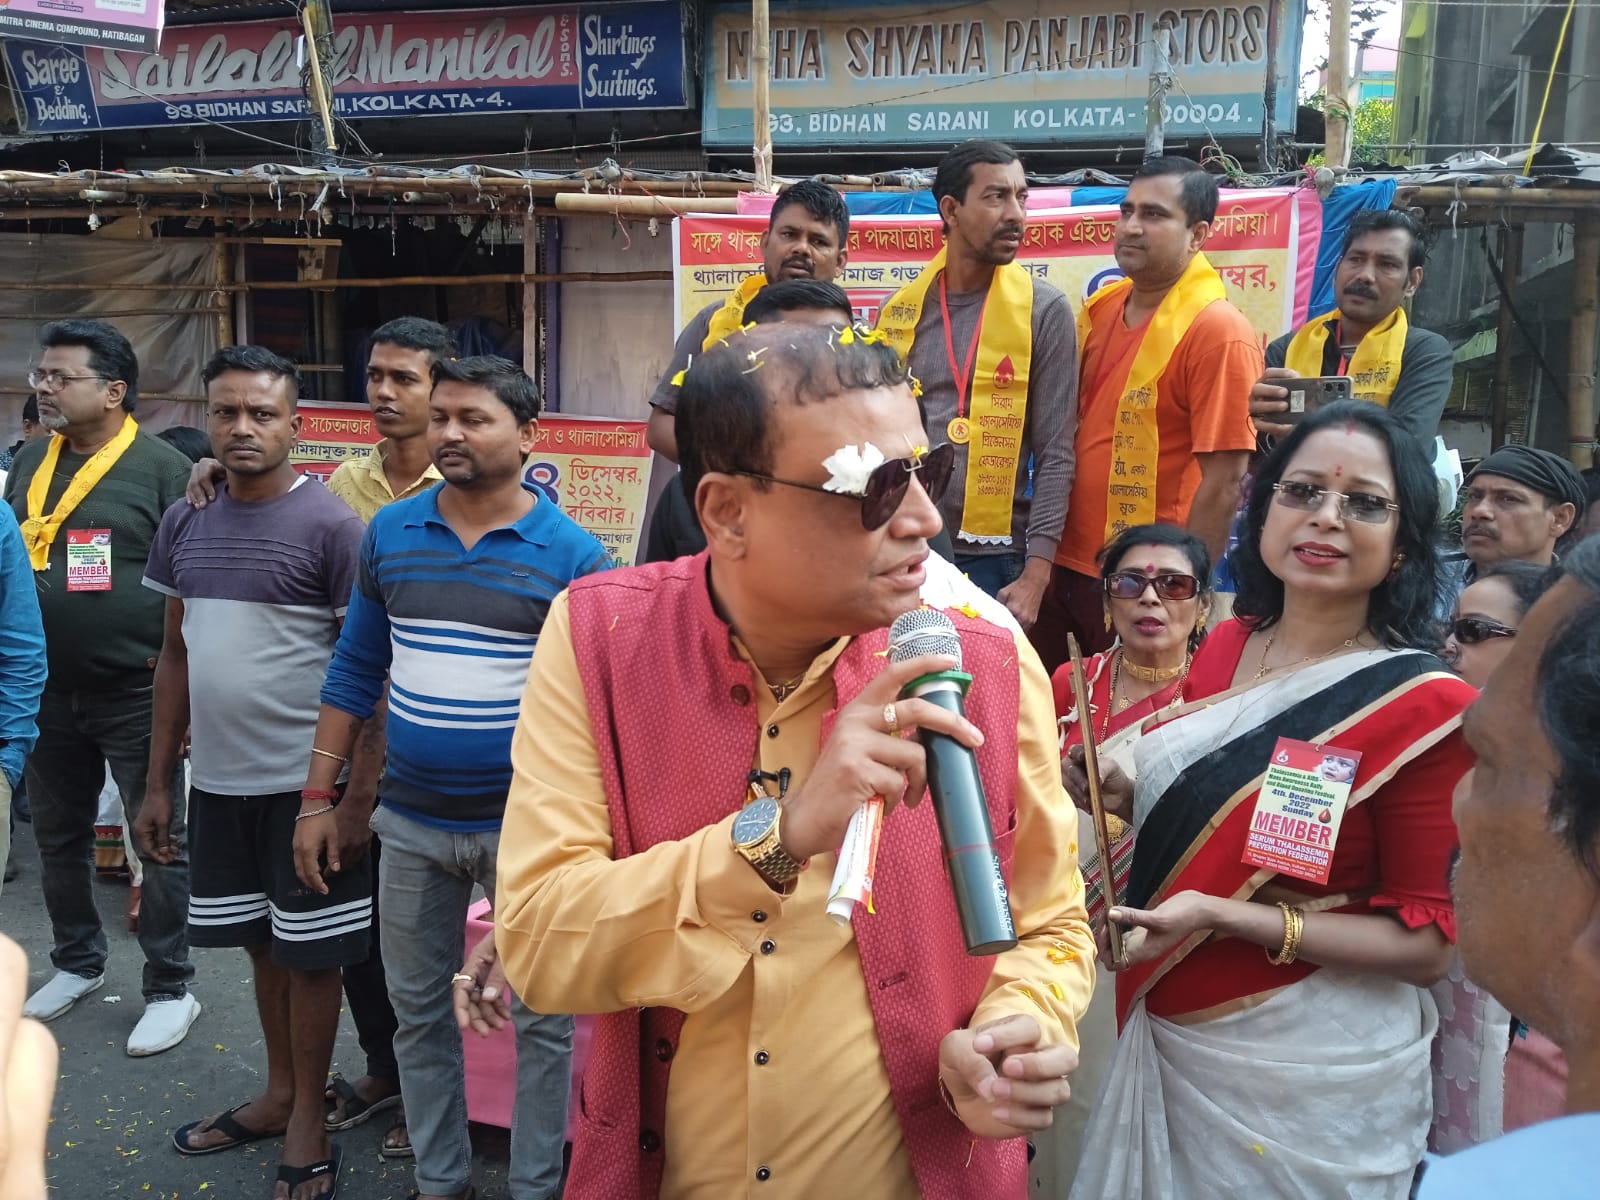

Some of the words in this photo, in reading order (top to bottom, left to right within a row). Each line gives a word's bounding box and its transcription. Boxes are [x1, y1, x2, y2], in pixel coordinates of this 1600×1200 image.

[0, 15, 23, 26] MITRA
[25, 19, 54, 31] CINEMA
[56, 24, 100, 38] COMPOUND,
[102, 30, 145, 43] HATIBAGAN
[584, 14, 656, 70] Shirtings
[726, 27, 825, 81] NHA
[1002, 11, 1145, 75] PANJABI
[1152, 4, 1266, 66] STORS
[22, 49, 80, 89] Saree
[584, 62, 657, 101] Suitings.
[33, 96, 91, 126] Bedding.
[809, 112, 886, 133] BIDHAN
[907, 110, 989, 131] SARANI
[728, 228, 763, 259] থাকু
[1069, 215, 1118, 248] এইড
[69, 565, 109, 576] MEMBER
[1282, 805, 1314, 818] Sunday
[1288, 791, 1334, 808] December
[1289, 799, 1311, 810] 2022
[1254, 810, 1333, 847] MEMBER
[1248, 840, 1287, 857] PREVENTION
[1288, 849, 1329, 867] FEDERATION
[1249, 832, 1275, 846] SERUM
[1277, 837, 1329, 859] THALASSEMIA
